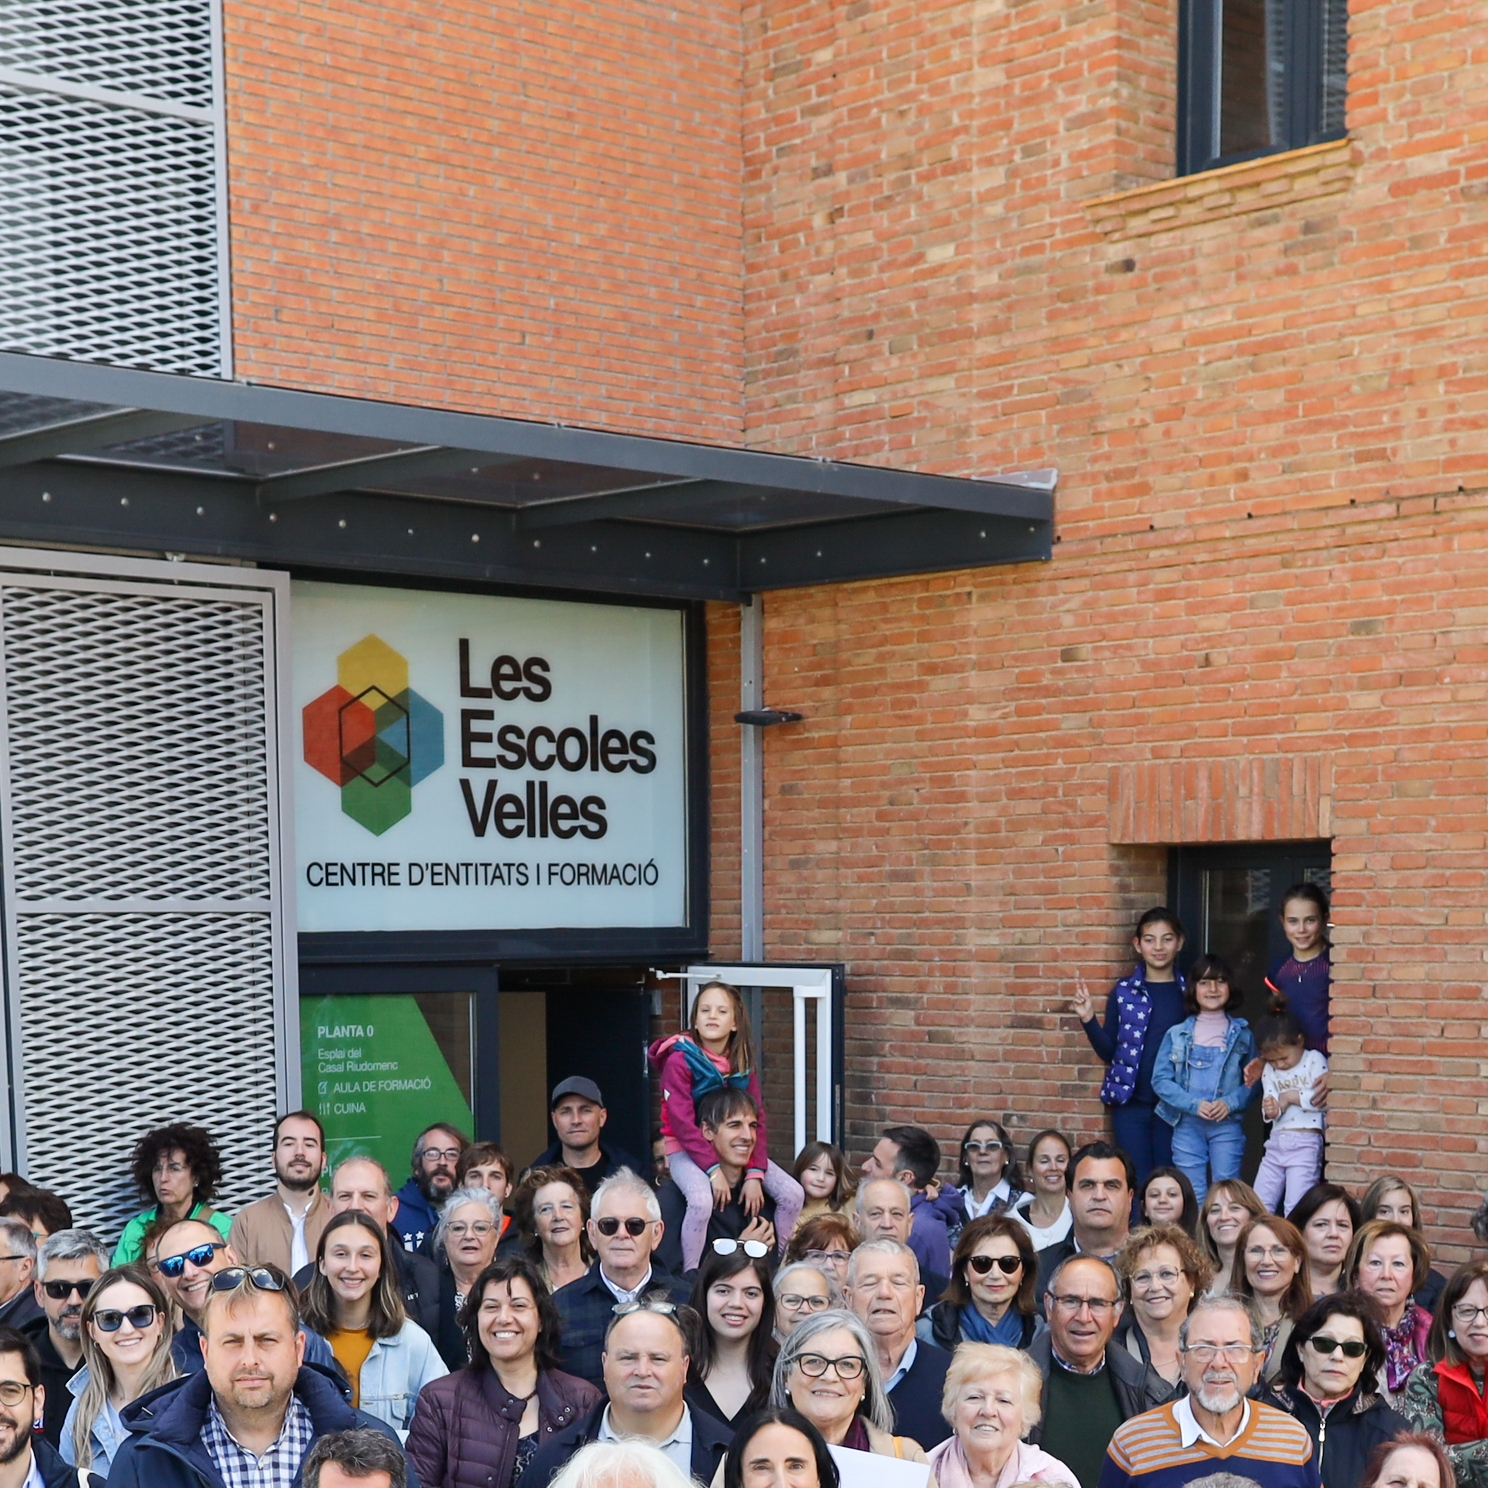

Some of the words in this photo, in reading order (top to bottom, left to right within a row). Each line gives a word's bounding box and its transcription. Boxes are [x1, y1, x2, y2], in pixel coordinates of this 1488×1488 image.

[458, 637, 553, 702] Les
[460, 708, 658, 775] Escoles
[458, 778, 609, 840] Velles
[306, 862, 402, 887] CENTRE
[408, 862, 530, 887] D'ENTITATS
[535, 863, 541, 886] I
[547, 857, 660, 887] FORMACIÓ
[317, 1025, 364, 1039] PLANTA
[366, 1025, 374, 1038] 0
[317, 1048, 346, 1061] Esplai
[347, 1047, 362, 1058] del
[317, 1061, 344, 1074] Casal
[346, 1060, 399, 1072] Riudomenc
[333, 1081, 361, 1093] AULA
[362, 1081, 377, 1092] DE
[378, 1076, 432, 1091] FORMACIÓ
[333, 1102, 367, 1115] CUINA
